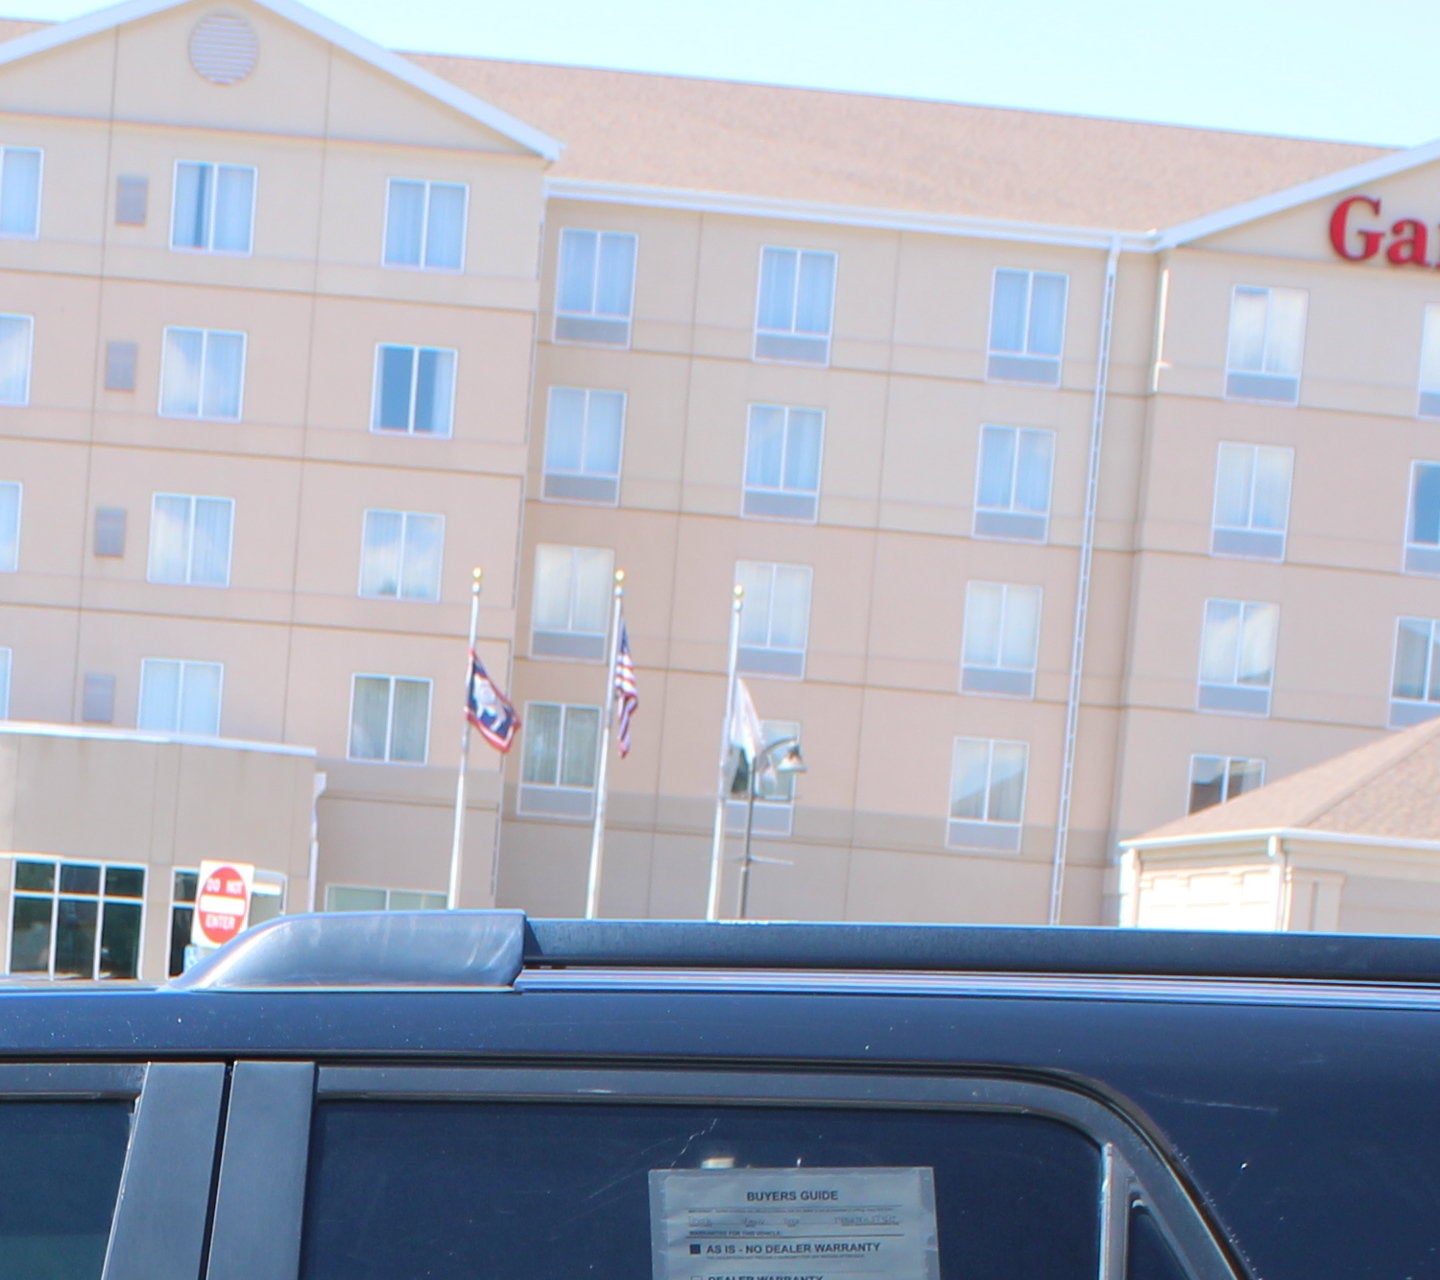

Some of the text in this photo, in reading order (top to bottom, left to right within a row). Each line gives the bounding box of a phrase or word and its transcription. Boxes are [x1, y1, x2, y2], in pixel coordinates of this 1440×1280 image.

[205, 915, 237, 931] ENTER
[746, 1190, 839, 1201] BUYERS GUIDE
[706, 1244, 722, 1254] AS
[725, 1244, 736, 1254] IS
[745, 1244, 763, 1254] NO
[765, 1243, 812, 1254] DEALER
[814, 1242, 881, 1253] WARRANTY
